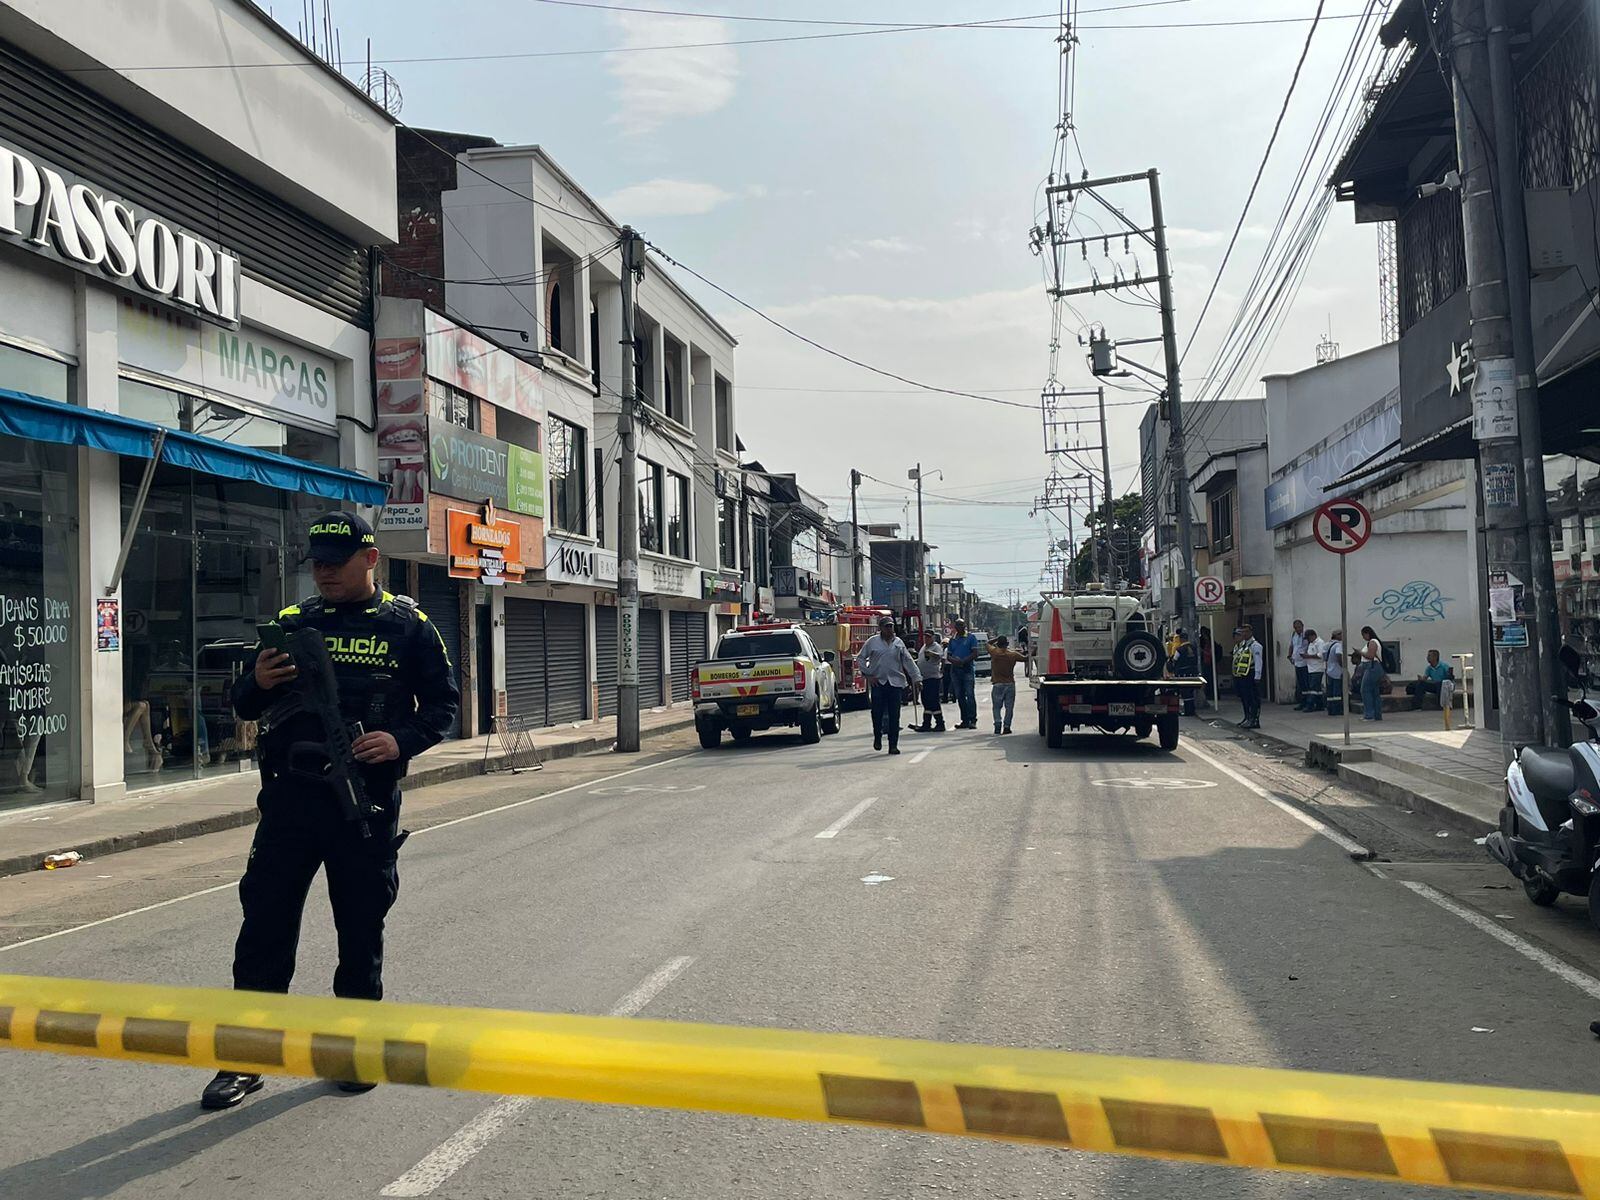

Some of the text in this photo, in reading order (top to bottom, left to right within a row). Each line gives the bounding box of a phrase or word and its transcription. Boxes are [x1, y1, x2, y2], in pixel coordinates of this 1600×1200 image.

[218, 332, 328, 409] MARCAS
[309, 521, 351, 536] POLICÍA
[395, 517, 406, 526] 753
[1331, 508, 1361, 542] P
[471, 524, 511, 546] HORNEADOS
[45, 599, 71, 620] DAMA
[324, 635, 389, 656] OLICÍA
[710, 668, 782, 680] BOMBEROS JAMUNDI
